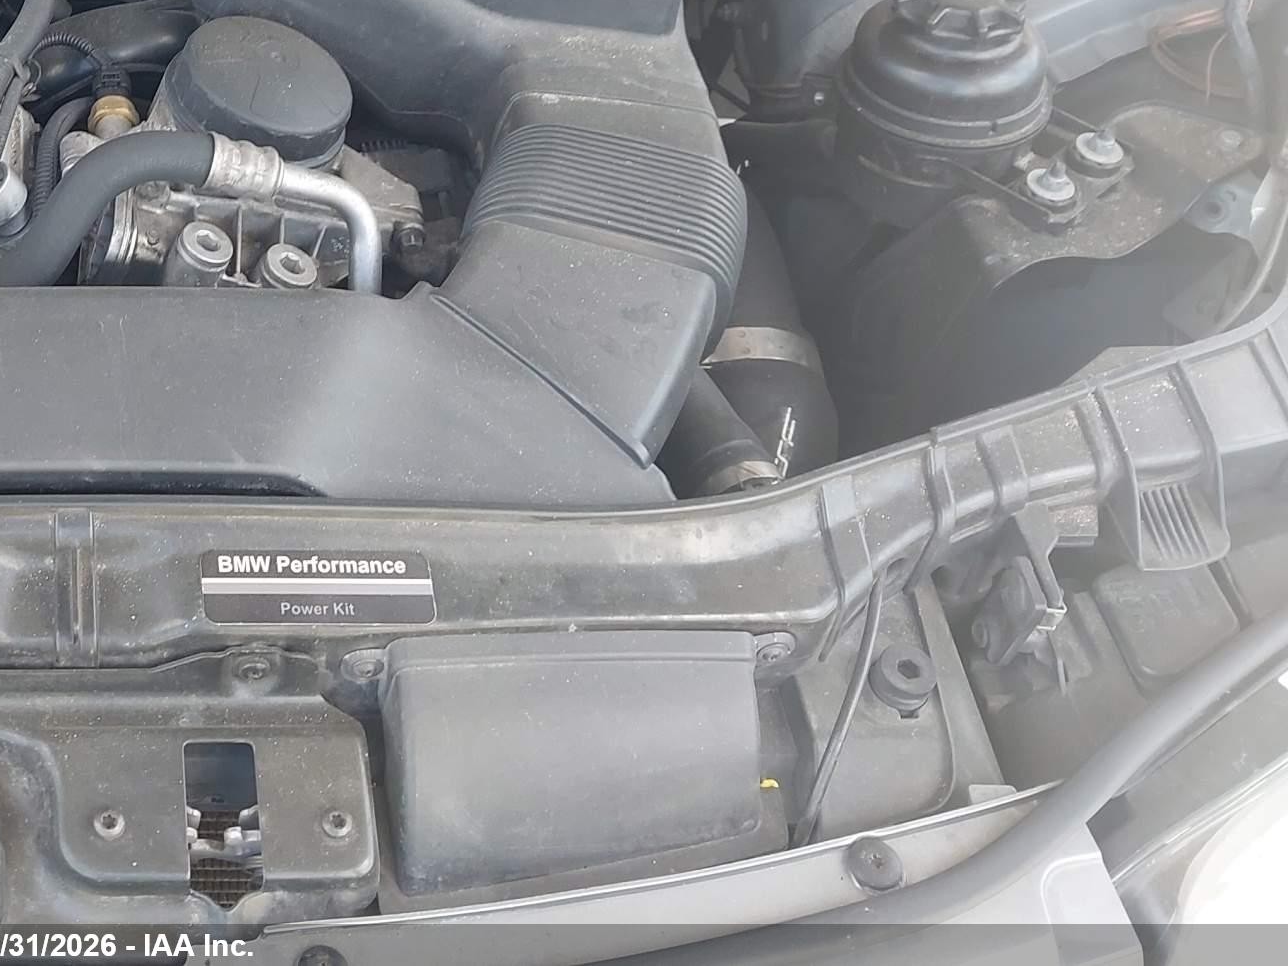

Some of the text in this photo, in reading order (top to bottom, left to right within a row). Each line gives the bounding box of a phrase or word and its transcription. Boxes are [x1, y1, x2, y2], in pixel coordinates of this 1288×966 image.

[217, 555, 407, 574] BMW Performance
[280, 602, 355, 616] Power Kit
